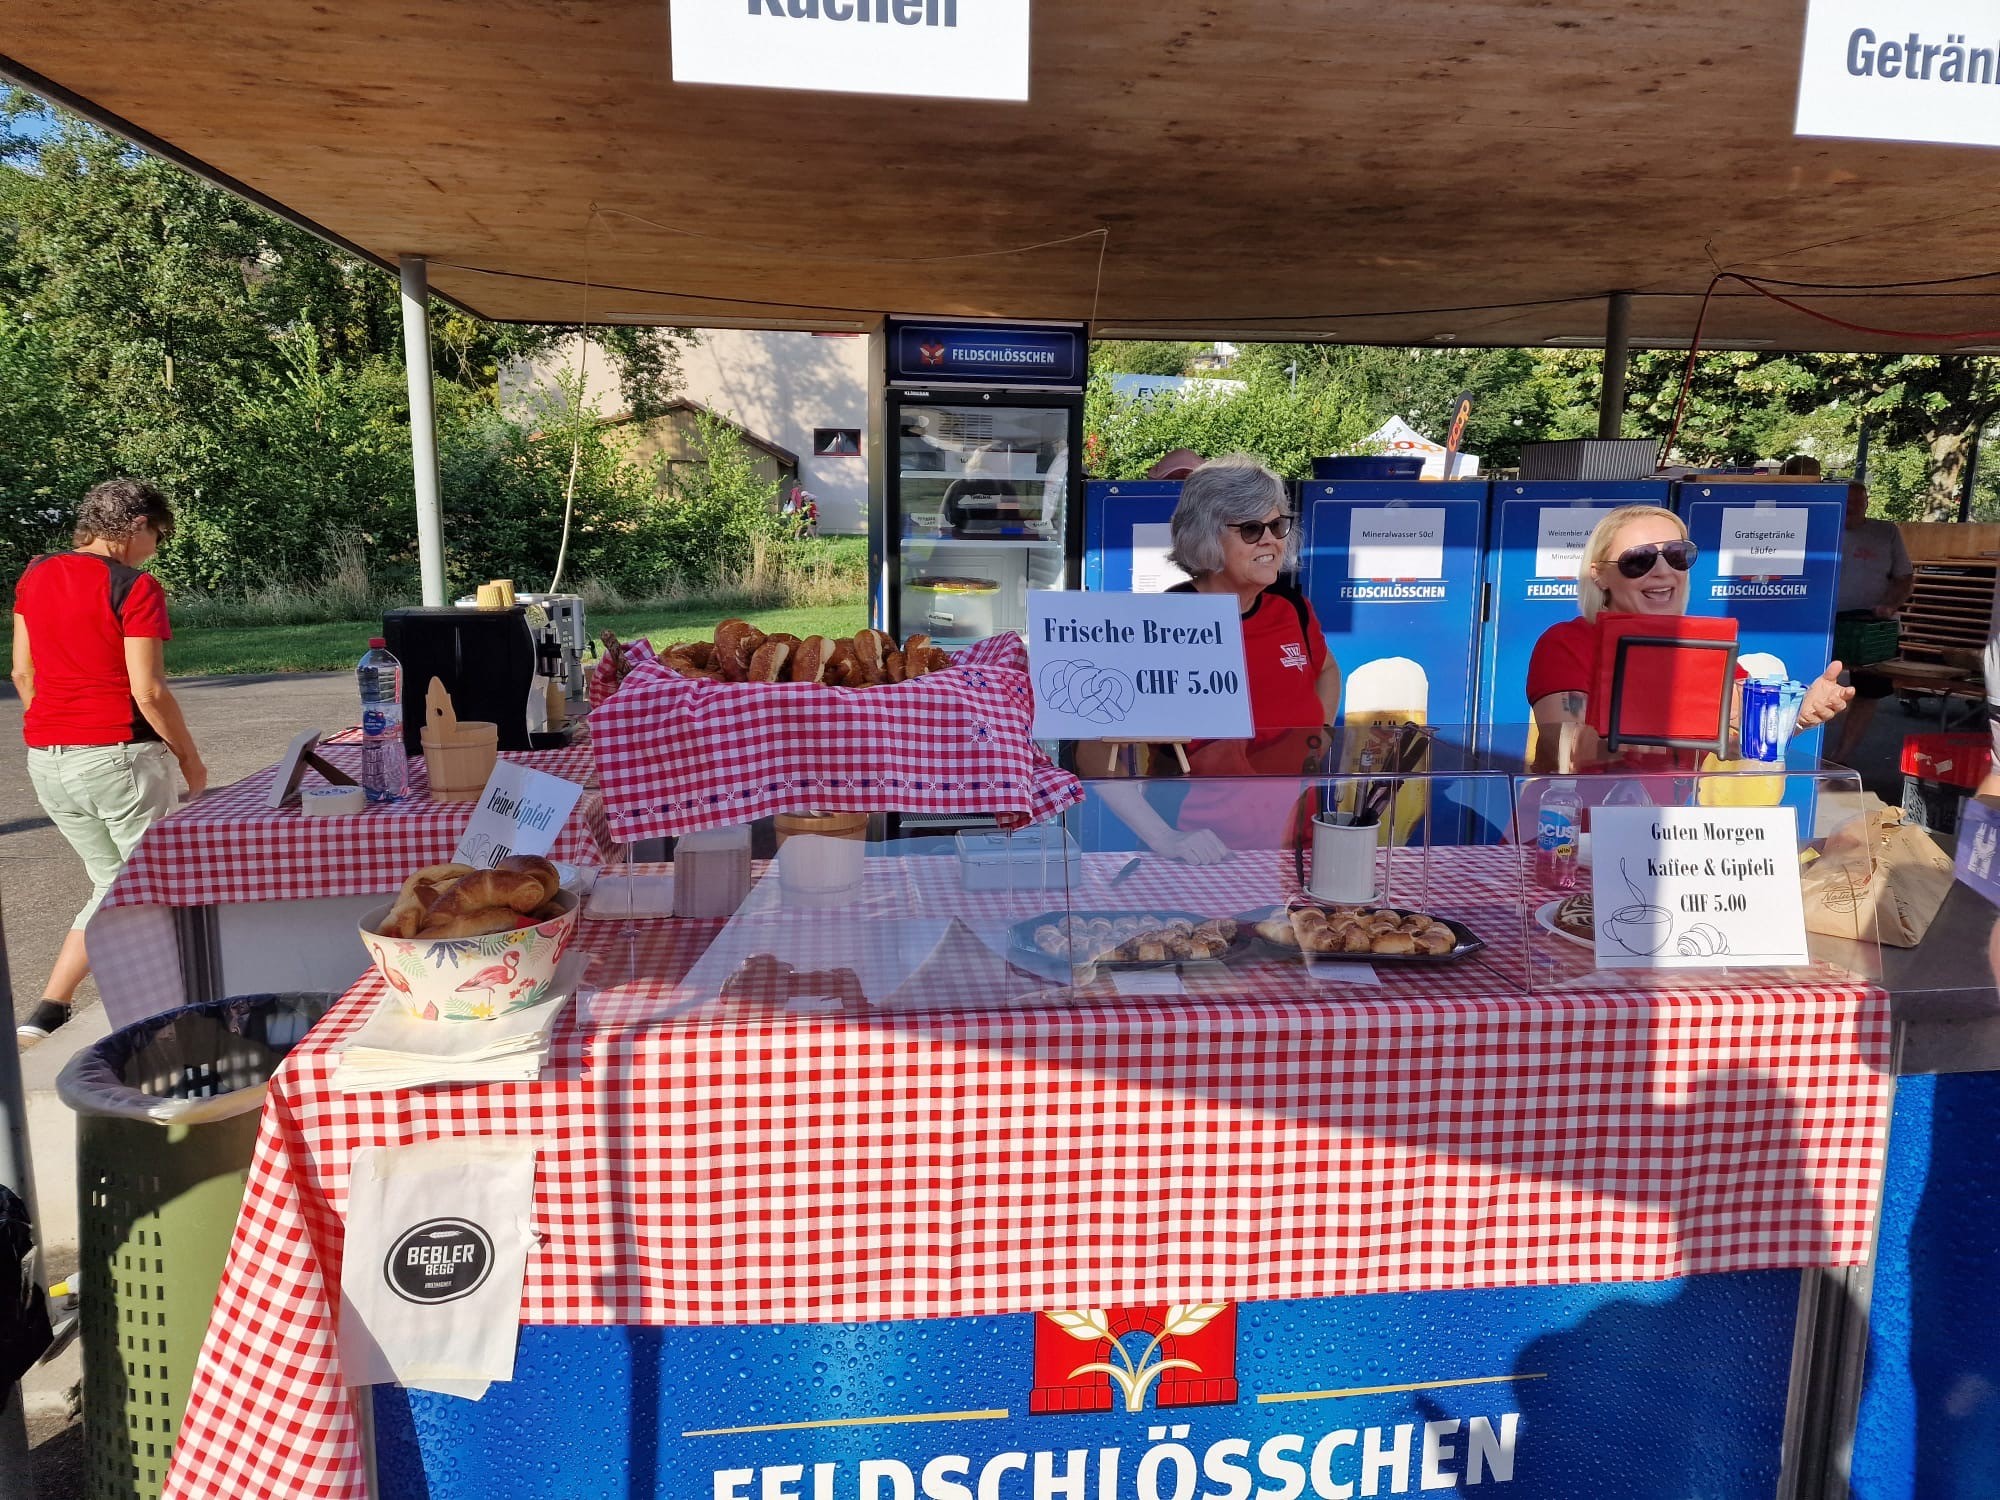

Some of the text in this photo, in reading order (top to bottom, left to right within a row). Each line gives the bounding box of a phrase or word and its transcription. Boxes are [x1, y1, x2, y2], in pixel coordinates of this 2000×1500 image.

[747, 0, 957, 27] uchen
[1847, 28, 2000, 84] Geträn
[952, 348, 1055, 364] FELDSCHLÖSSCHEN
[1362, 530, 1434, 538] Mineralwasser 50cl
[1735, 530, 1796, 540] Gratisgetränke
[1750, 546, 1777, 555] Läufer
[1340, 583, 1445, 598] FELDSCHLÖSSCHEN
[1527, 584, 1578, 596] FELDSCHL
[1711, 581, 1807, 597] FELDSCHLÖSSCHEN
[1043, 617, 1224, 645] Frische Brezel
[1136, 669, 1238, 695] CHF 5.00
[486, 787, 555, 832] Feine Gipfeli
[1651, 822, 1765, 846] Guten Morgen
[1647, 858, 1775, 881] Kaffee & Gipfeli
[1680, 893, 1747, 913] CHF 5.00
[407, 1244, 475, 1265] BEBLER
[425, 1263, 455, 1276] BEGG
